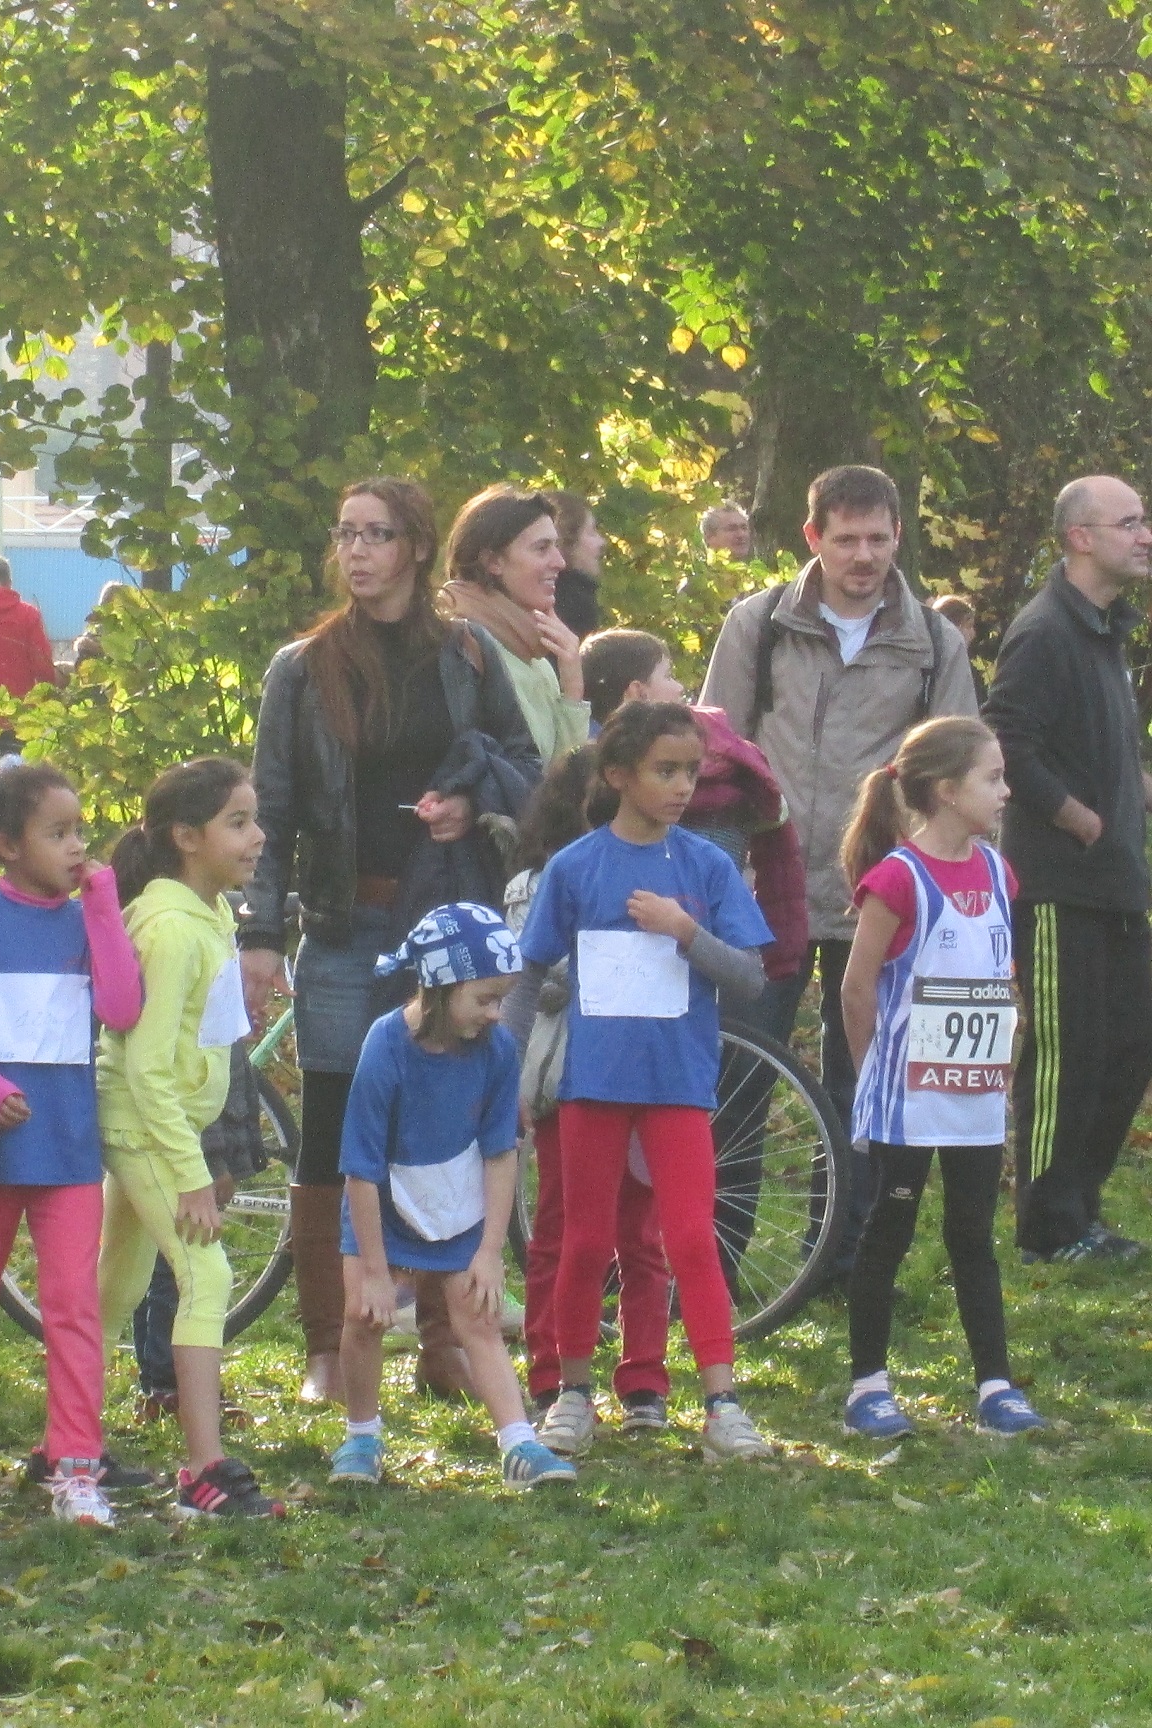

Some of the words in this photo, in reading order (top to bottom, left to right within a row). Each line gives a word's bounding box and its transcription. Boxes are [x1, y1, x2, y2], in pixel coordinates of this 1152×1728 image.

[944, 1012, 1000, 1059] 997
[920, 1067, 1005, 1088] AREVA
[244, 1200, 288, 1210] SPORT
